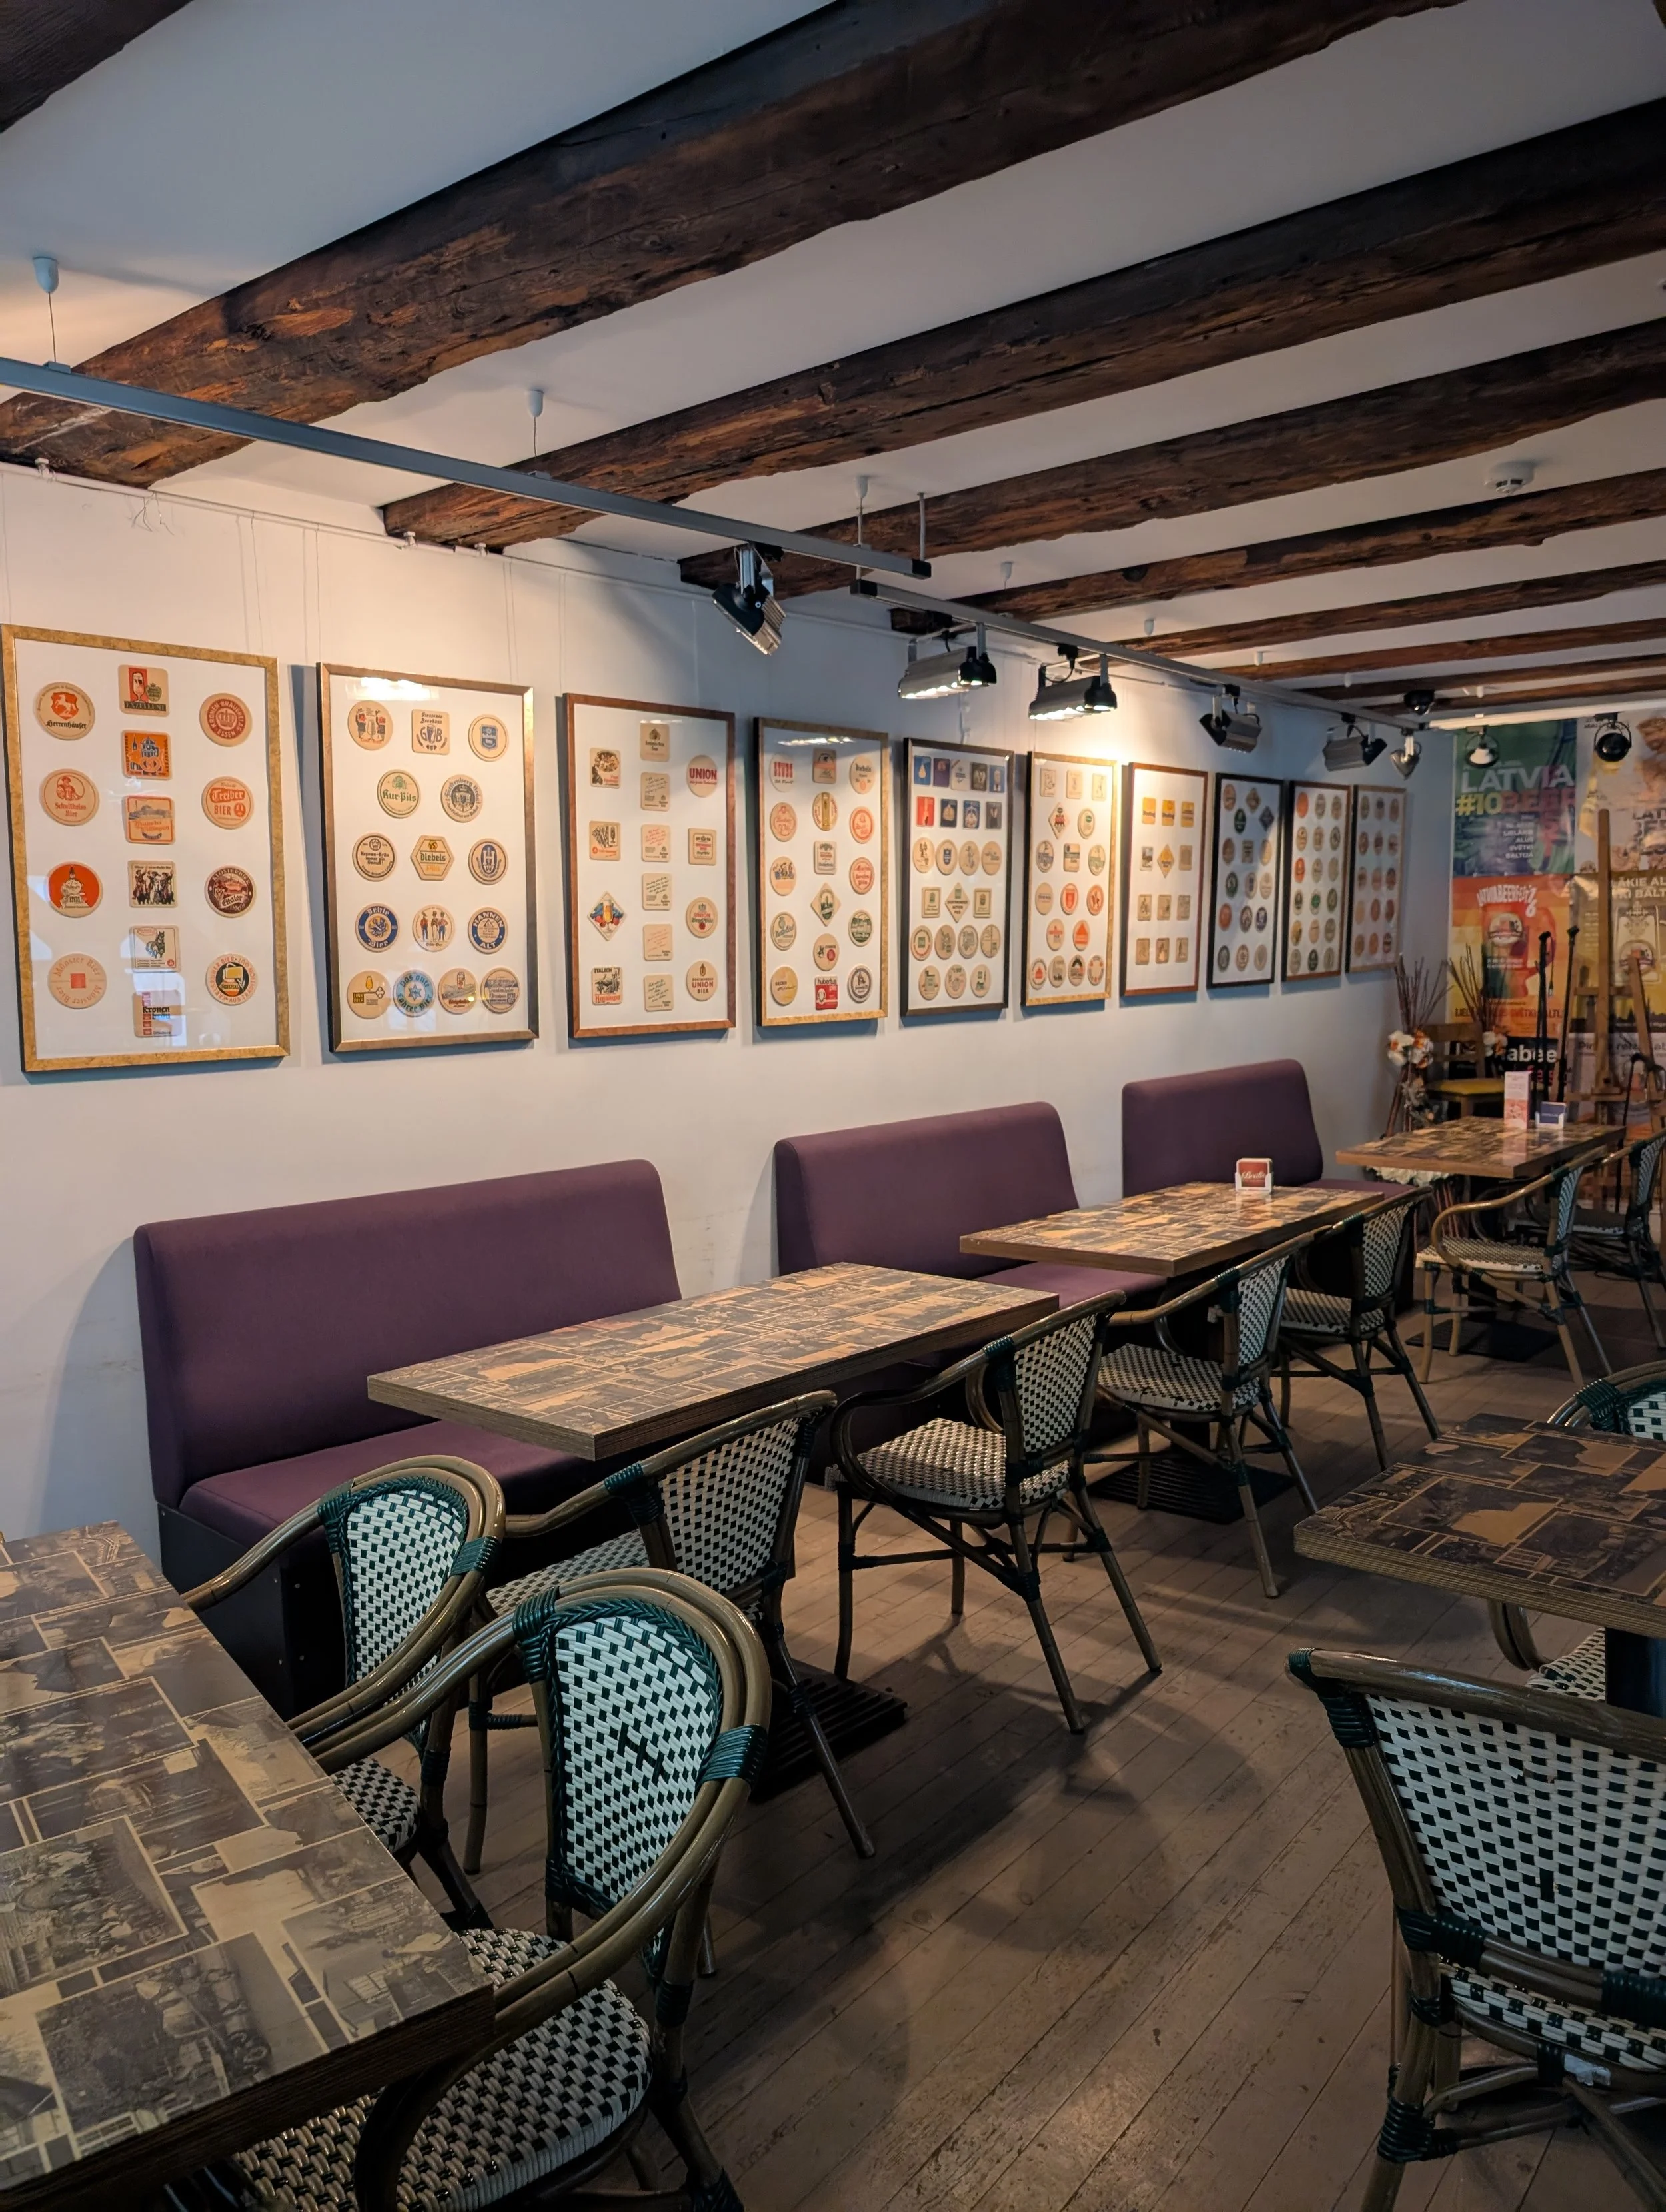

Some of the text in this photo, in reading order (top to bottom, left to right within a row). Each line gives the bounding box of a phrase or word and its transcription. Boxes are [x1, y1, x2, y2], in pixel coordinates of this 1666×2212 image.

[46, 720, 87, 730] Herrenhäuser
[689, 767, 718, 780] UNION
[1461, 764, 1575, 793] LATVIA
[213, 804, 231, 816] BIER
[420, 853, 446, 862] Diebels
[1650, 876, 1666, 887] AL
[473, 911, 504, 927] HANNEN
